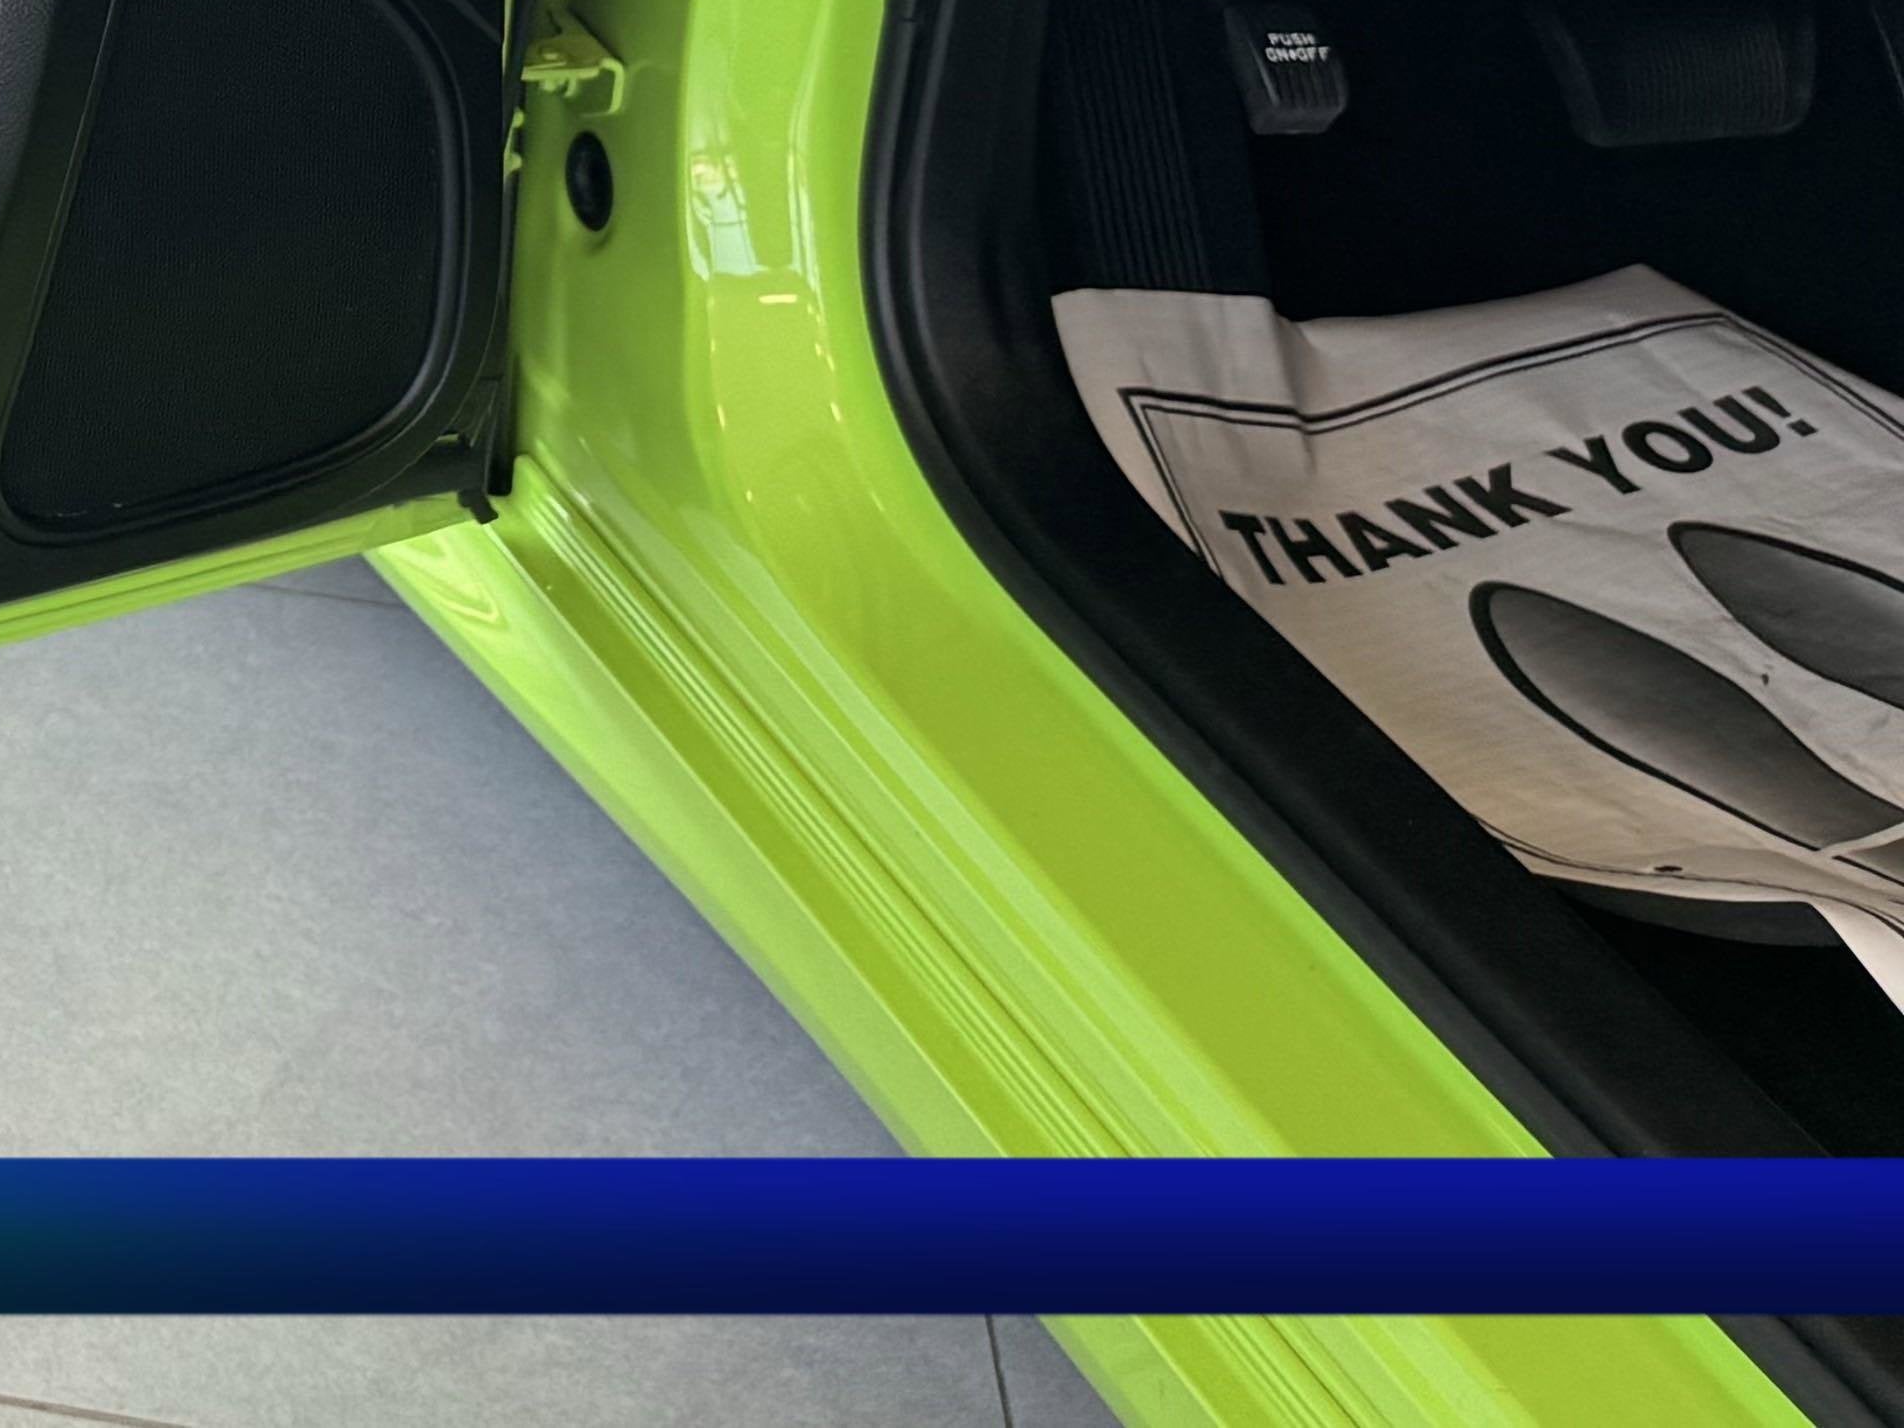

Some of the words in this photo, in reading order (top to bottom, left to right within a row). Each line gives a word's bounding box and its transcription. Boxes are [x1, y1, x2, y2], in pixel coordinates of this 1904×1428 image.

[1267, 32, 1316, 46] PUSH
[1219, 462, 1572, 587] THANK
[1546, 384, 1819, 495] YOU!
